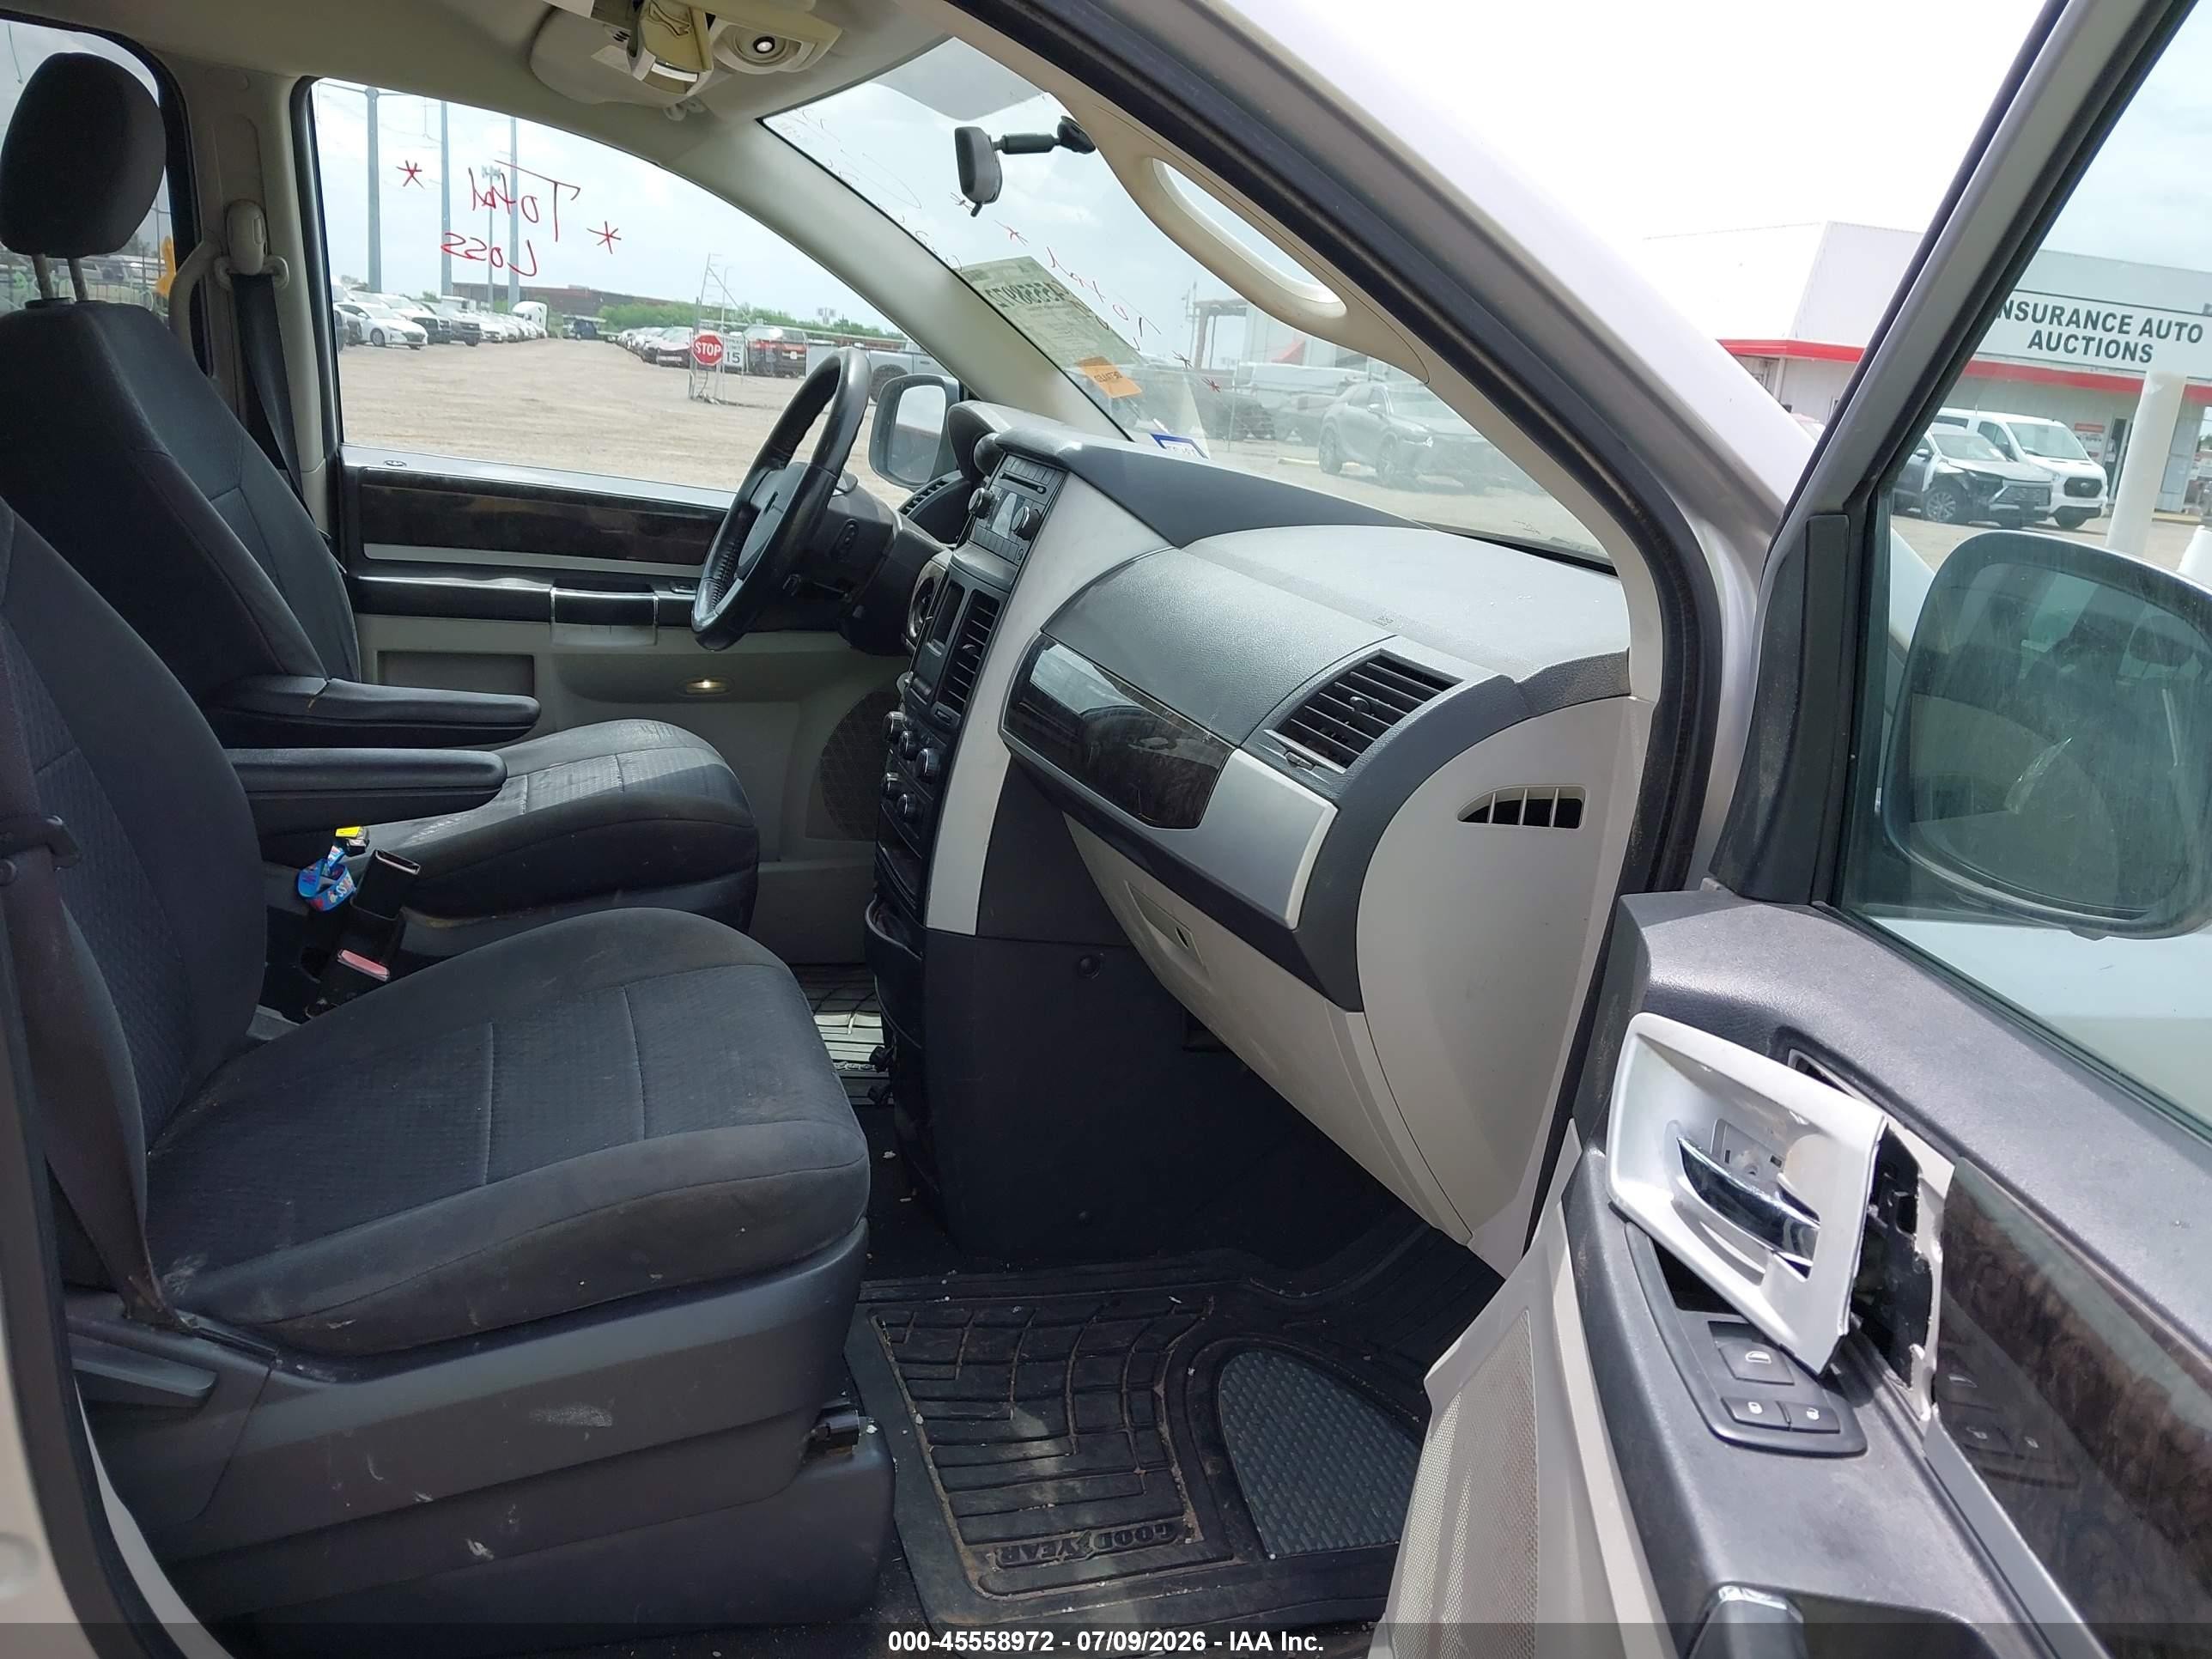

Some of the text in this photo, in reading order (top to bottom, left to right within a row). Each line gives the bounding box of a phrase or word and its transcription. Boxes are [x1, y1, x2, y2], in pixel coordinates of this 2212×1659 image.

[1997, 300, 2203, 343] NSURANCE AUTO
[695, 341, 721, 356] STOP
[726, 352, 740, 363] 15
[2027, 330, 2154, 363] AUCTIONS
[1000, 1522, 1178, 1565] GOODYEAR
